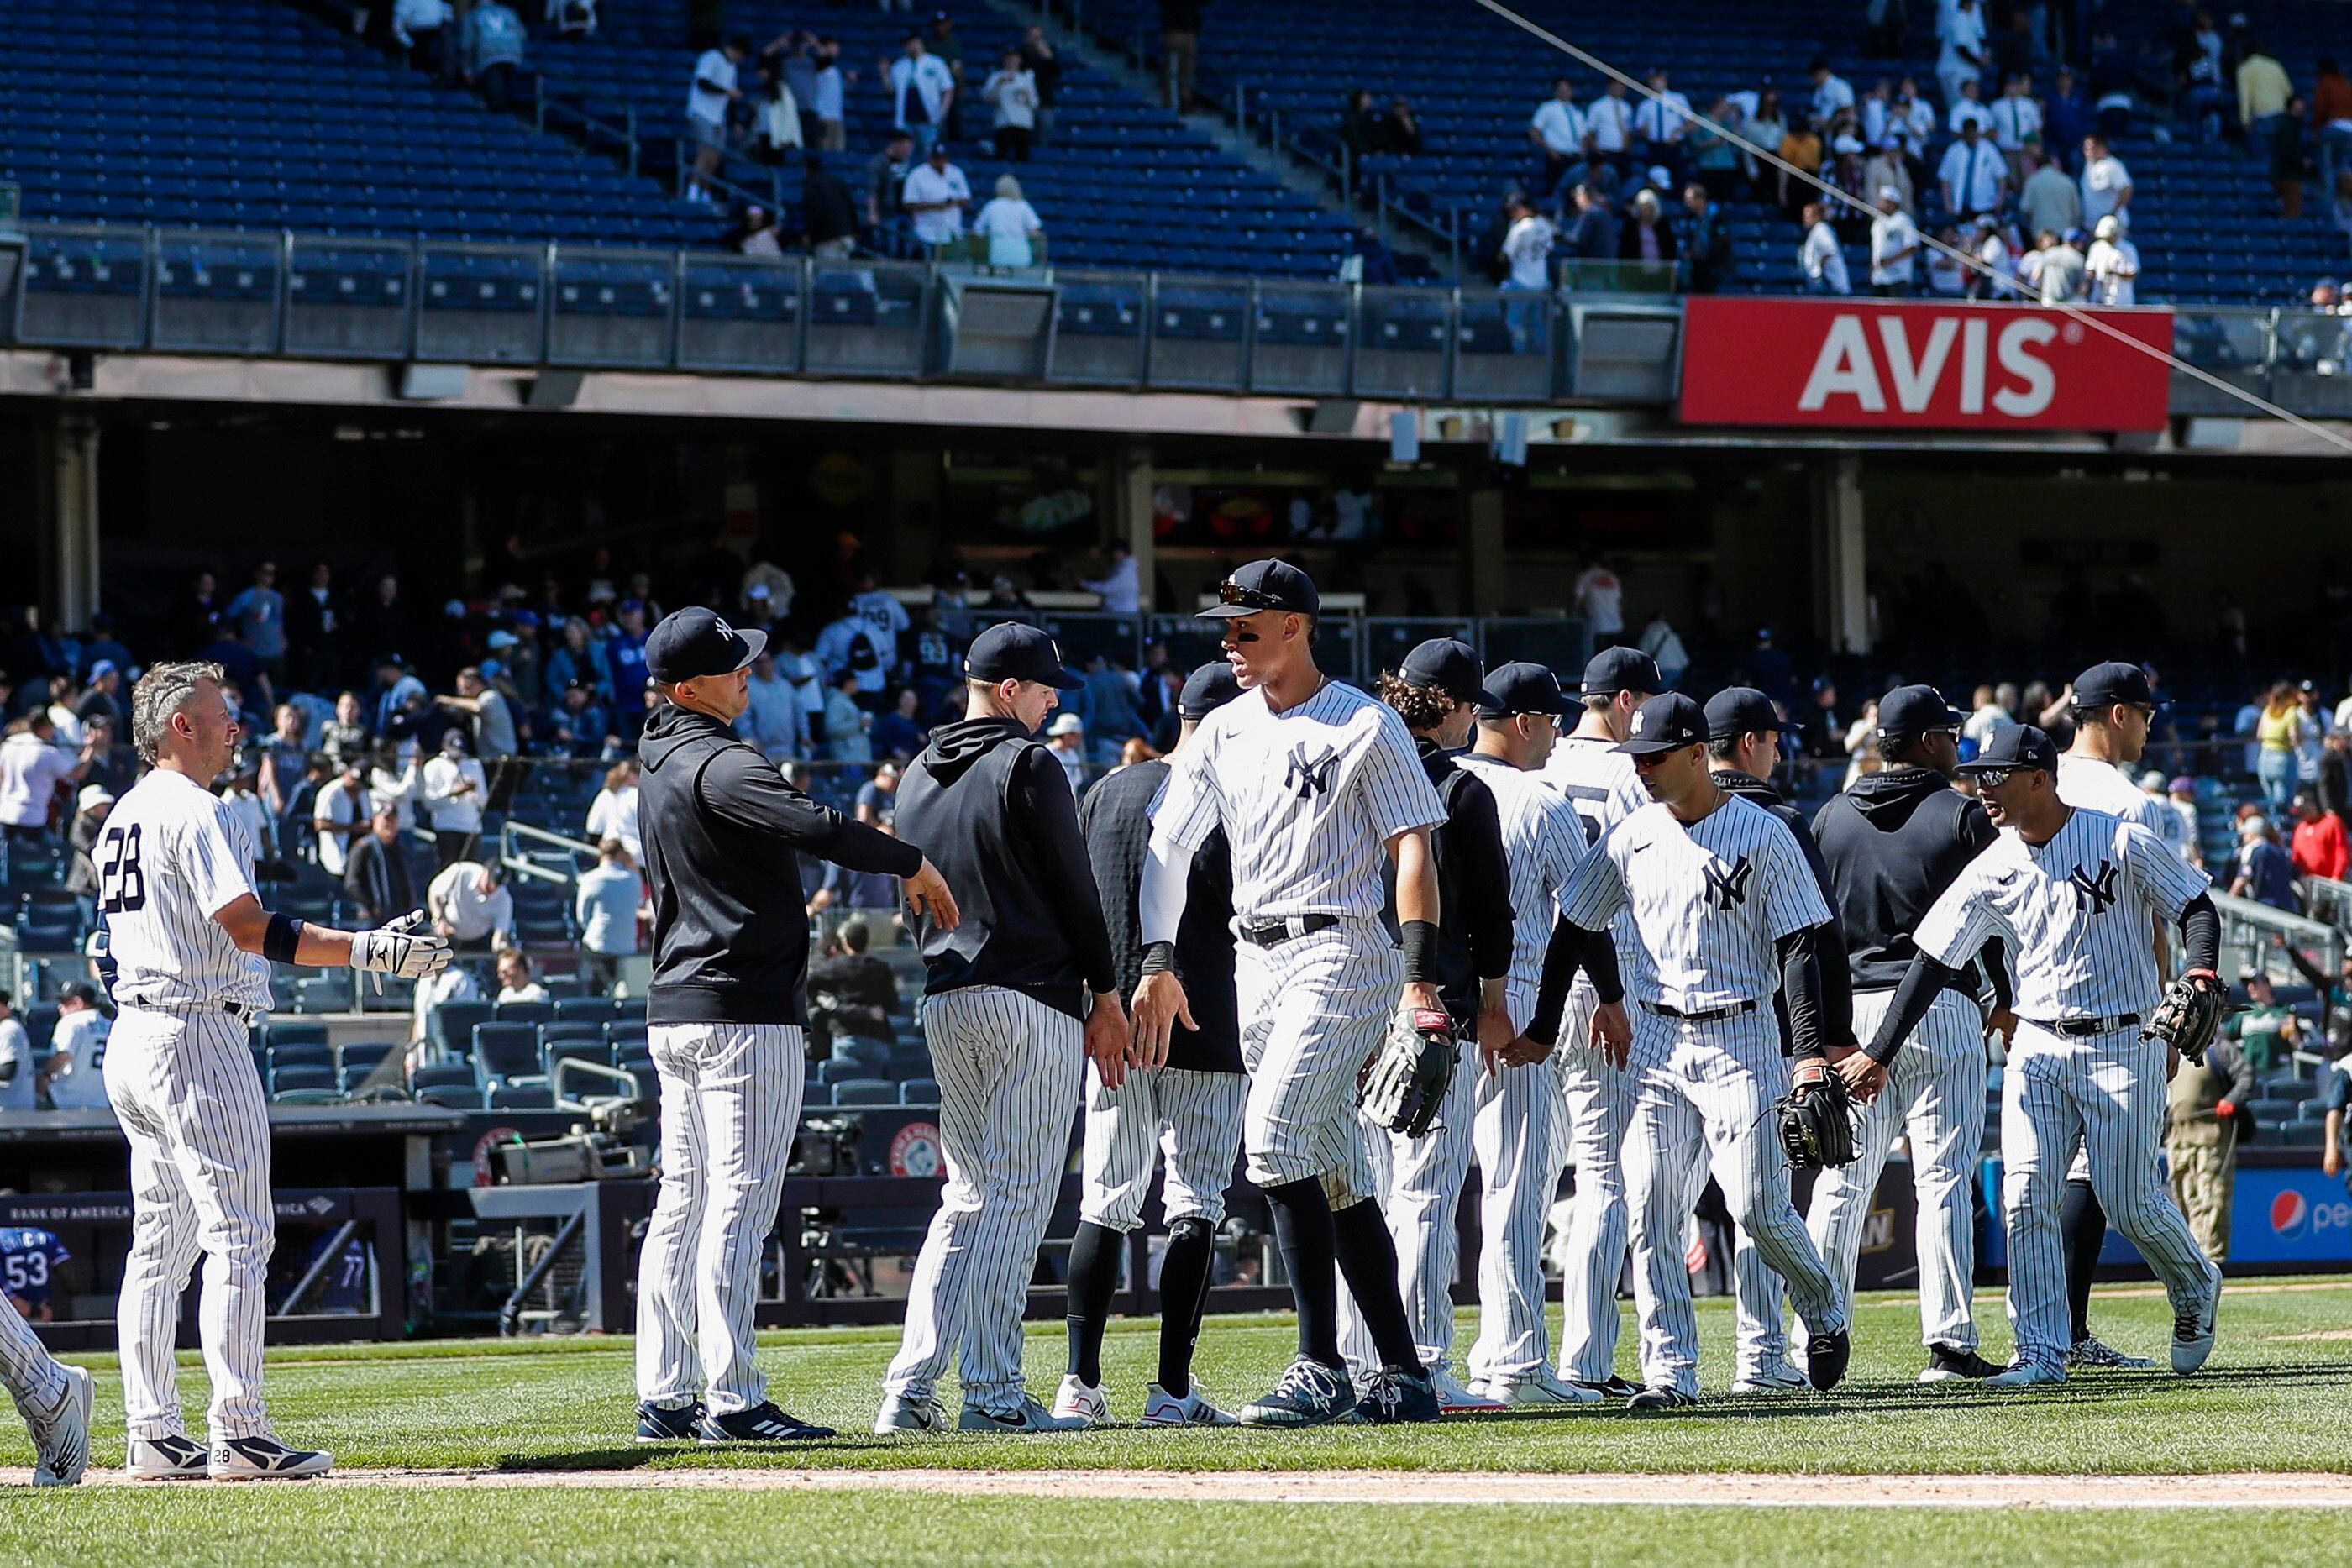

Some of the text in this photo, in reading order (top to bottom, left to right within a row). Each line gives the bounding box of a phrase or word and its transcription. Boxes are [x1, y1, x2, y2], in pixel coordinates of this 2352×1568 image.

[1798, 313, 2057, 418] AVIS
[1284, 741, 1341, 799] NY
[103, 823, 146, 914] 28
[1701, 856, 1753, 911] NY
[2068, 858, 2119, 915] NY
[10, 1204, 132, 1220] BANK OF AMERICA
[275, 1203, 307, 1215] RICA
[2313, 1202, 2352, 1234] pe
[5, 1251, 49, 1291] 53
[341, 1254, 365, 1289] 77
[213, 1449, 231, 1465] 28
